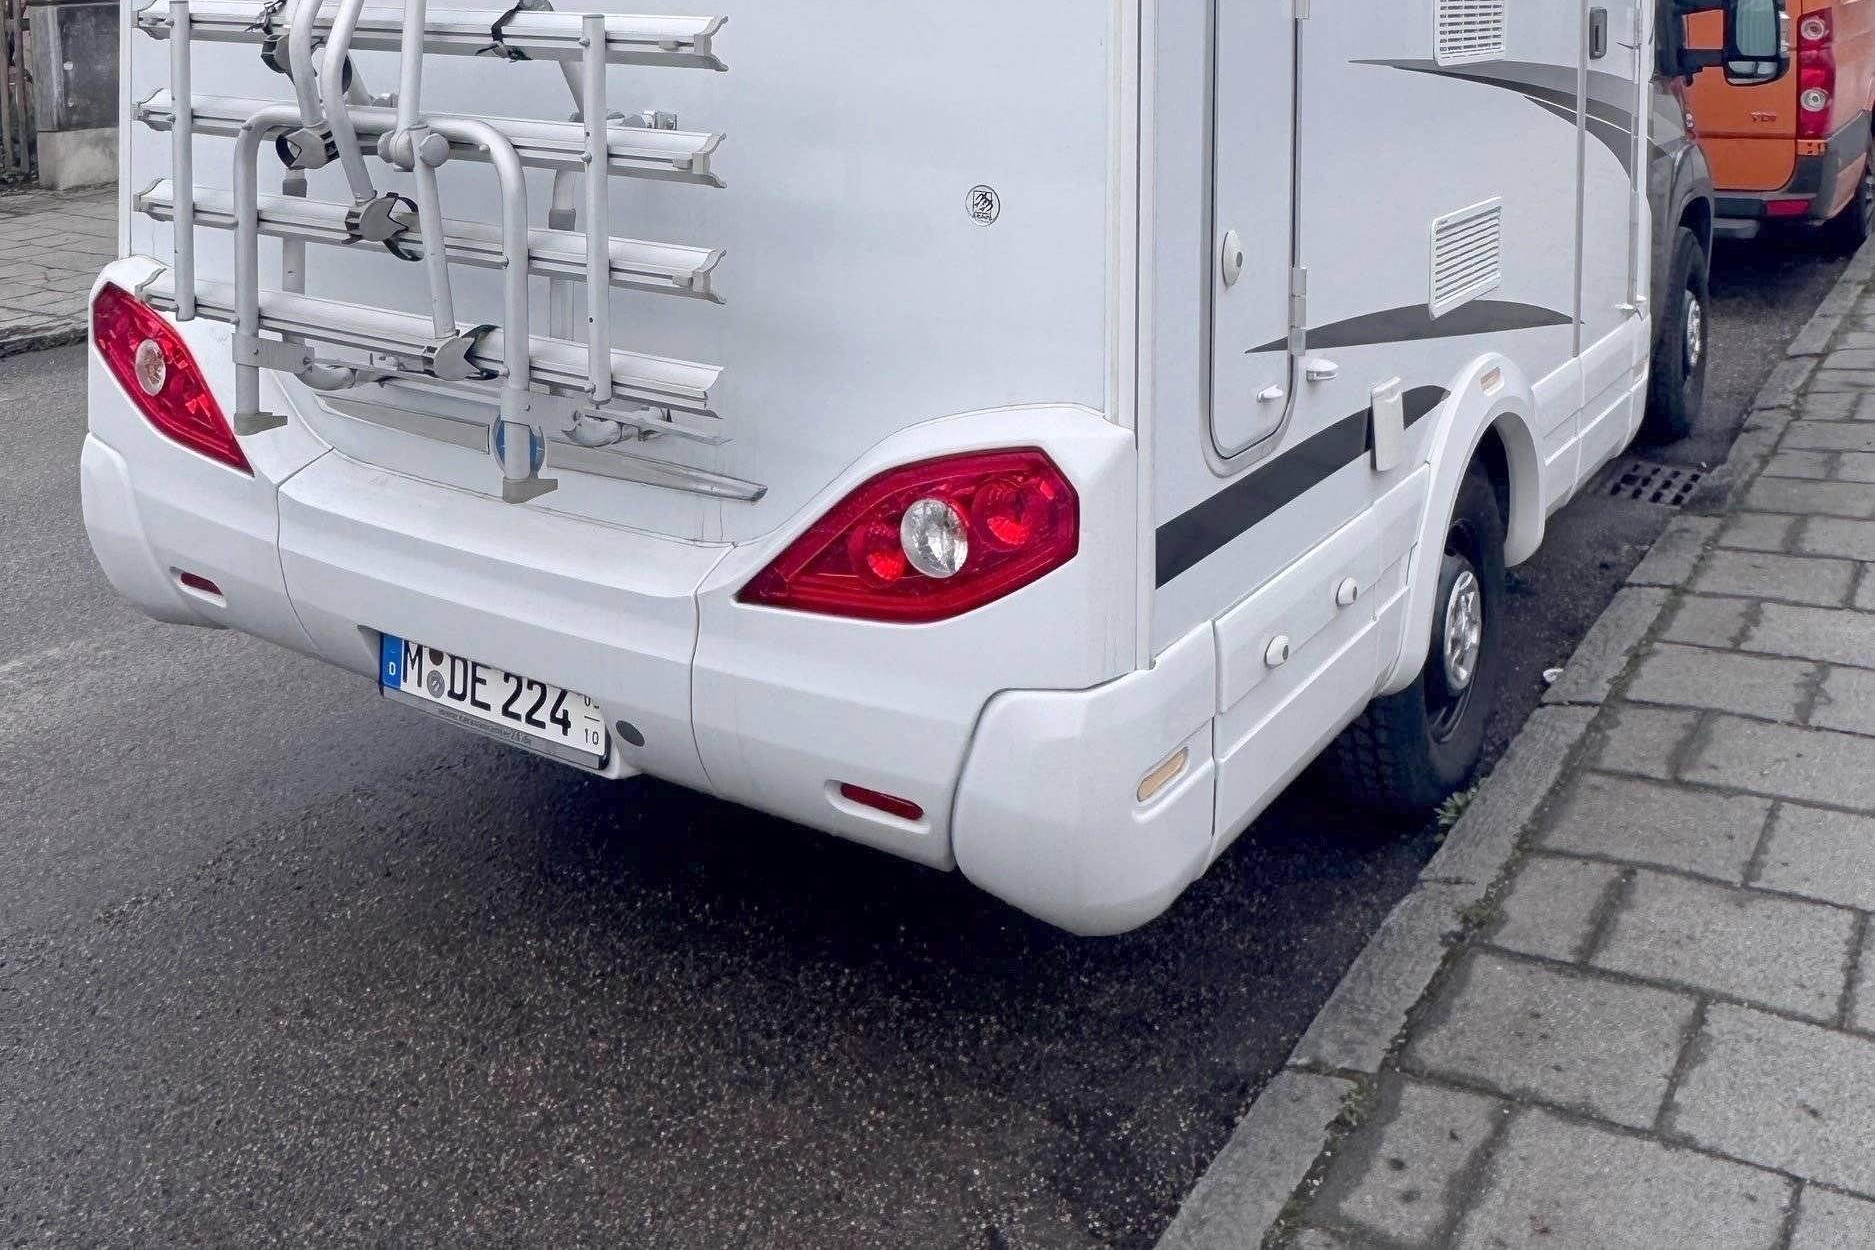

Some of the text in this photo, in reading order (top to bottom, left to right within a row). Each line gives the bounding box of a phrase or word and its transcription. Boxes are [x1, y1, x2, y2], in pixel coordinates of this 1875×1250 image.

[402, 639, 424, 688] M
[447, 654, 492, 712] DE
[501, 671, 572, 737] 224
[584, 727, 600, 746] 10
